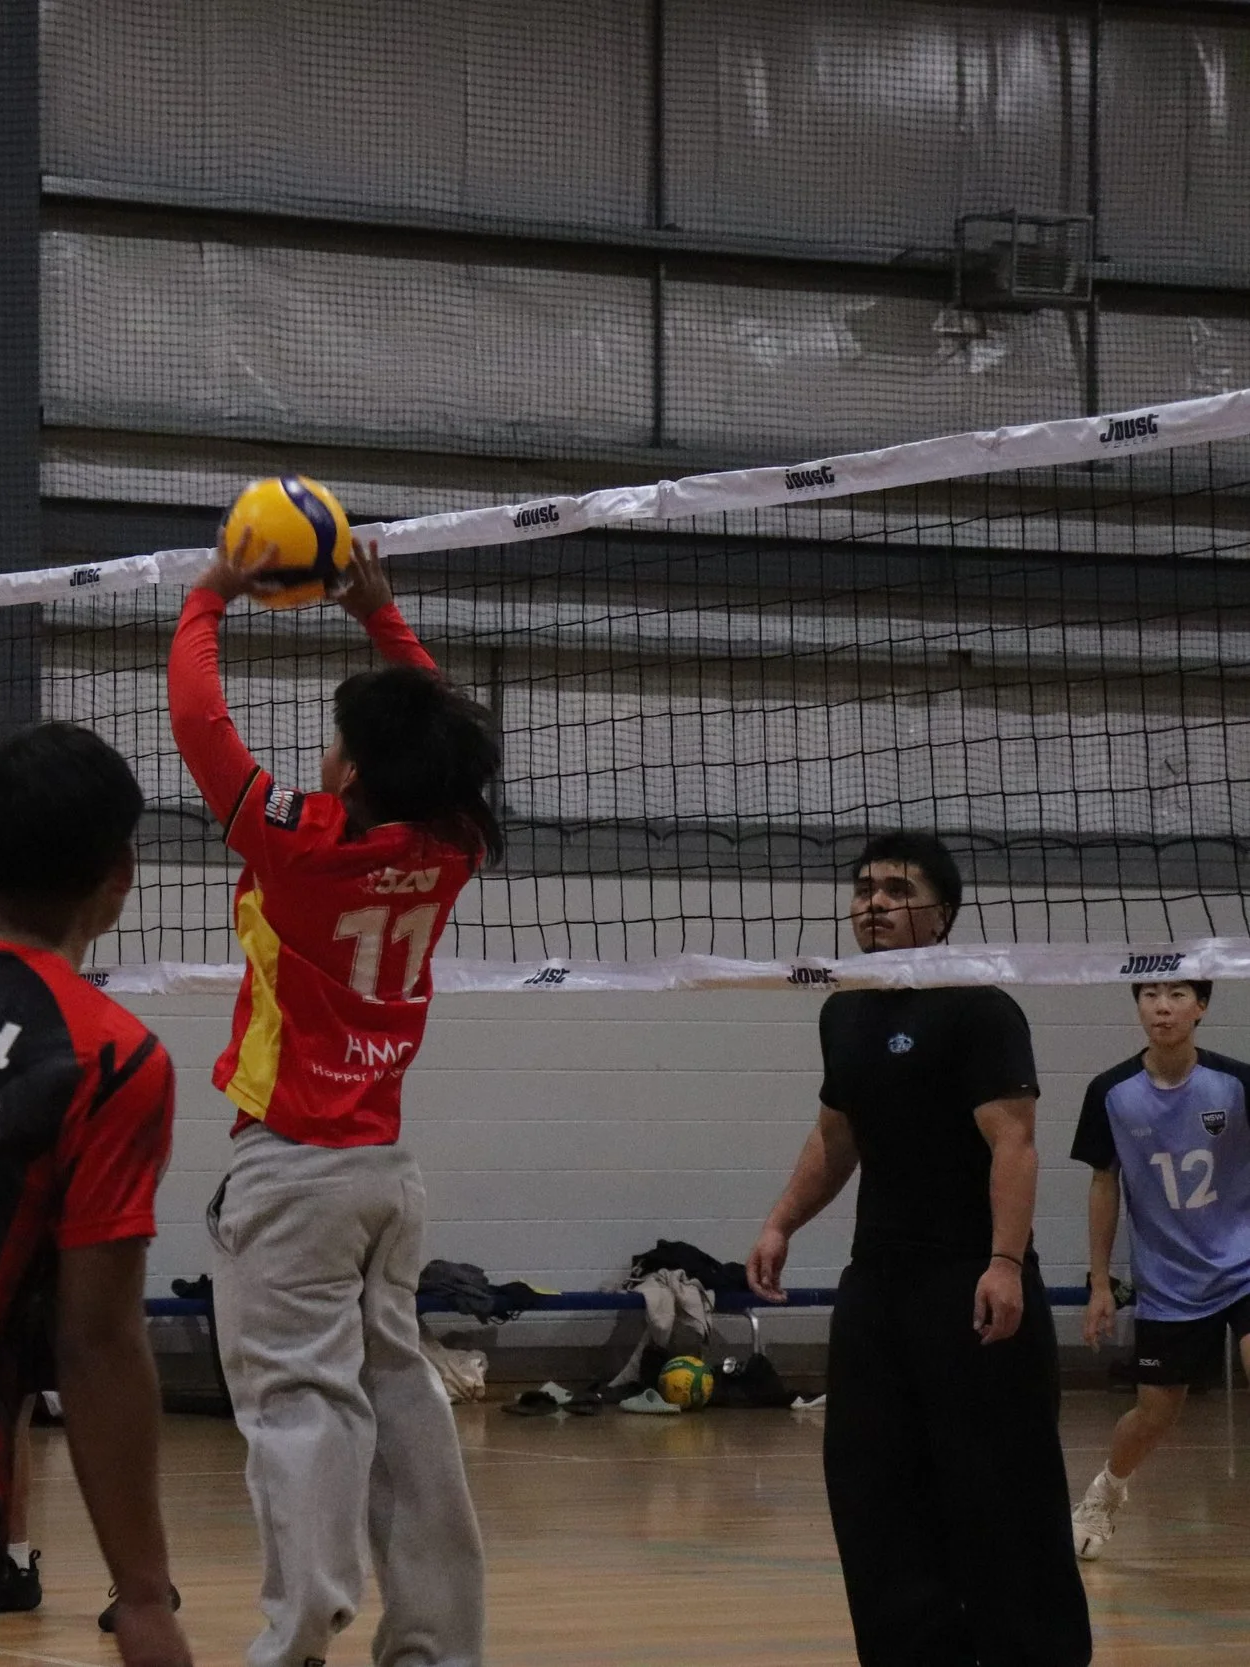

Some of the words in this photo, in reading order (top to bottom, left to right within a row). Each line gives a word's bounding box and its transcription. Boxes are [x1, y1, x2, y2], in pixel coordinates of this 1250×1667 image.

[333, 903, 440, 1004] 11
[312, 1063, 367, 1083] Hopper
[1150, 1149, 1219, 1210] 12
